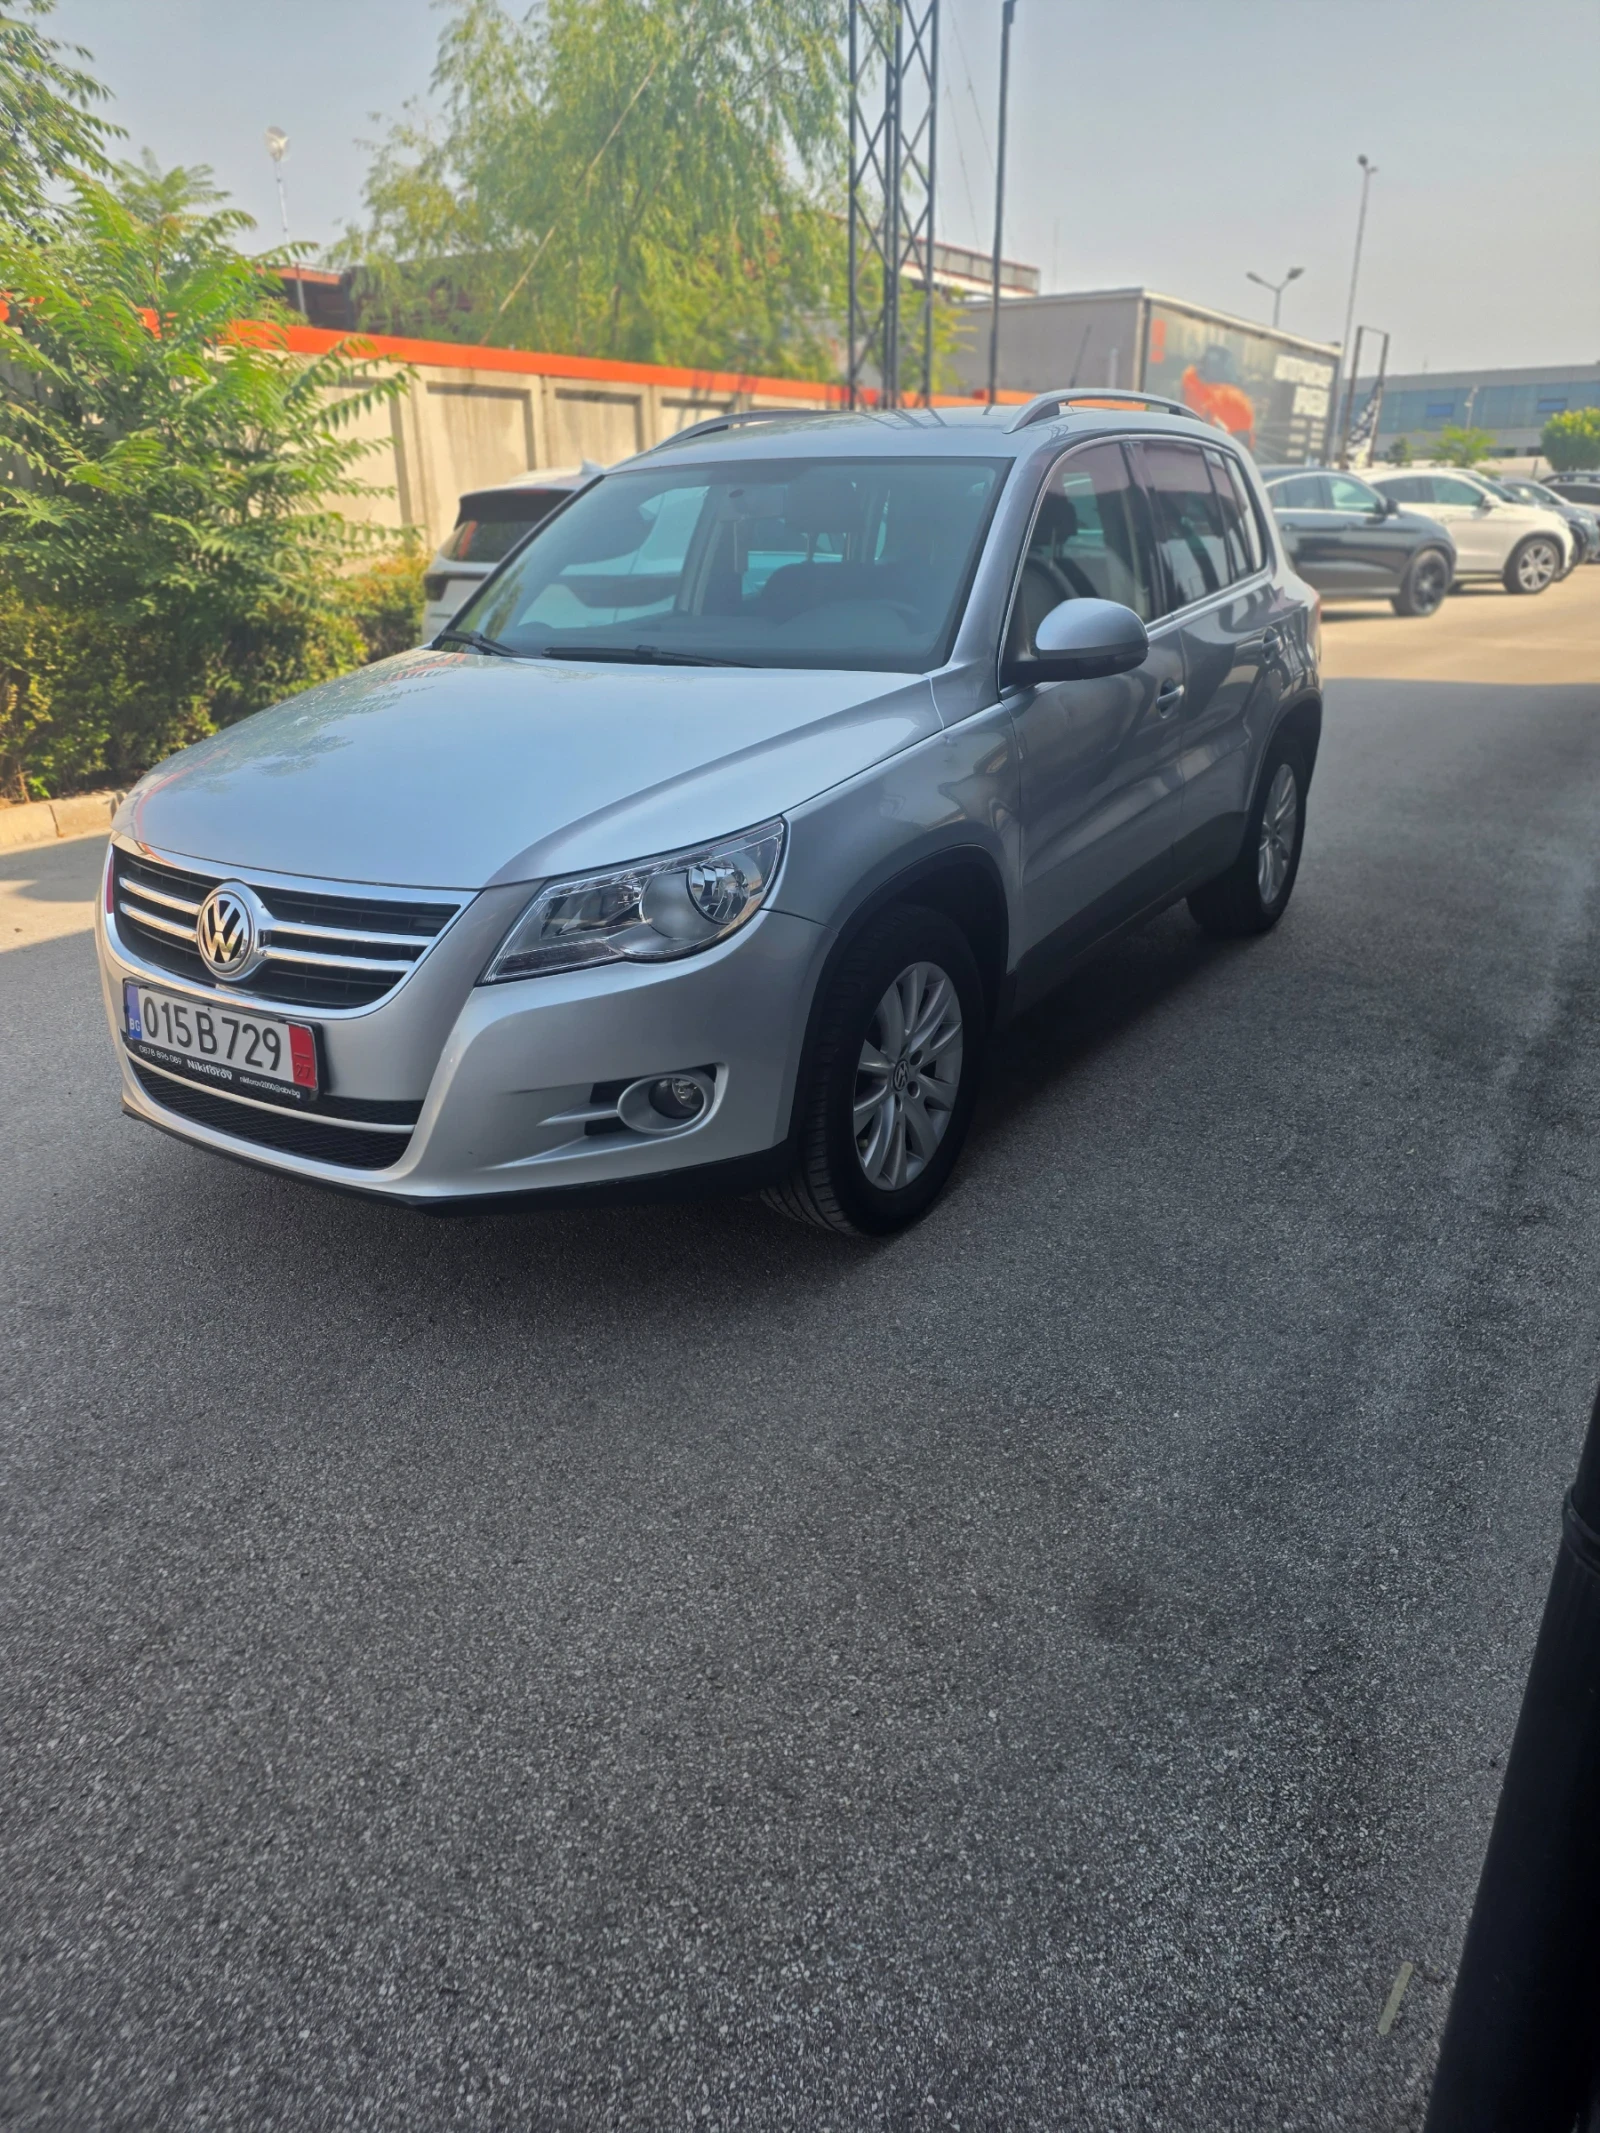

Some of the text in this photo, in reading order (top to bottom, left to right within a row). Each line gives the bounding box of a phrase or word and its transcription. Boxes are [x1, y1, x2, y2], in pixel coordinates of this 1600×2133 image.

[203, 893, 249, 966] VW
[129, 1018, 141, 1032] BG
[143, 996, 281, 1071] 015B729
[187, 1059, 233, 1081] Nikiforov
[296, 1063, 311, 1079] 27
